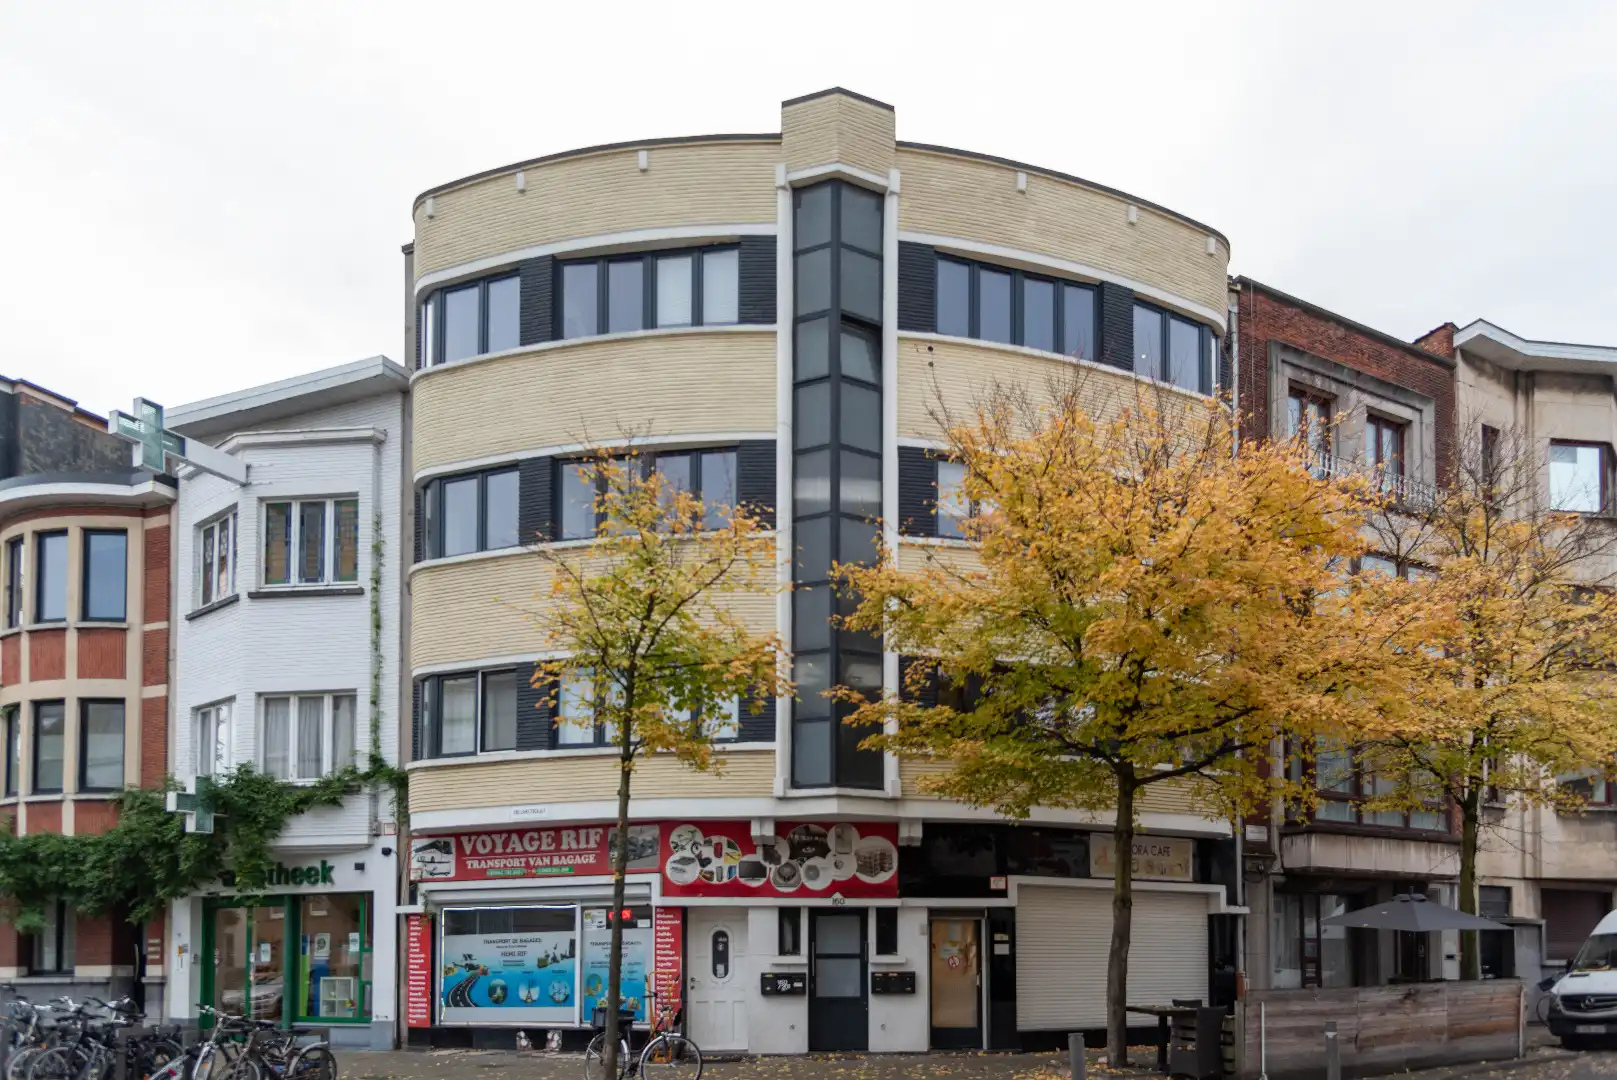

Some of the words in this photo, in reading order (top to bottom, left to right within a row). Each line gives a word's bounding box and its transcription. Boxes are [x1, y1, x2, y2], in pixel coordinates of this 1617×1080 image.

[460, 830, 556, 856] VOYAGE
[560, 827, 604, 850] RIF
[1150, 845, 1171, 857] CAFE
[466, 857, 527, 869] TRANSPORT
[528, 856, 550, 866] VAN
[552, 854, 597, 865] BAGAGE
[832, 897, 846, 906] 160
